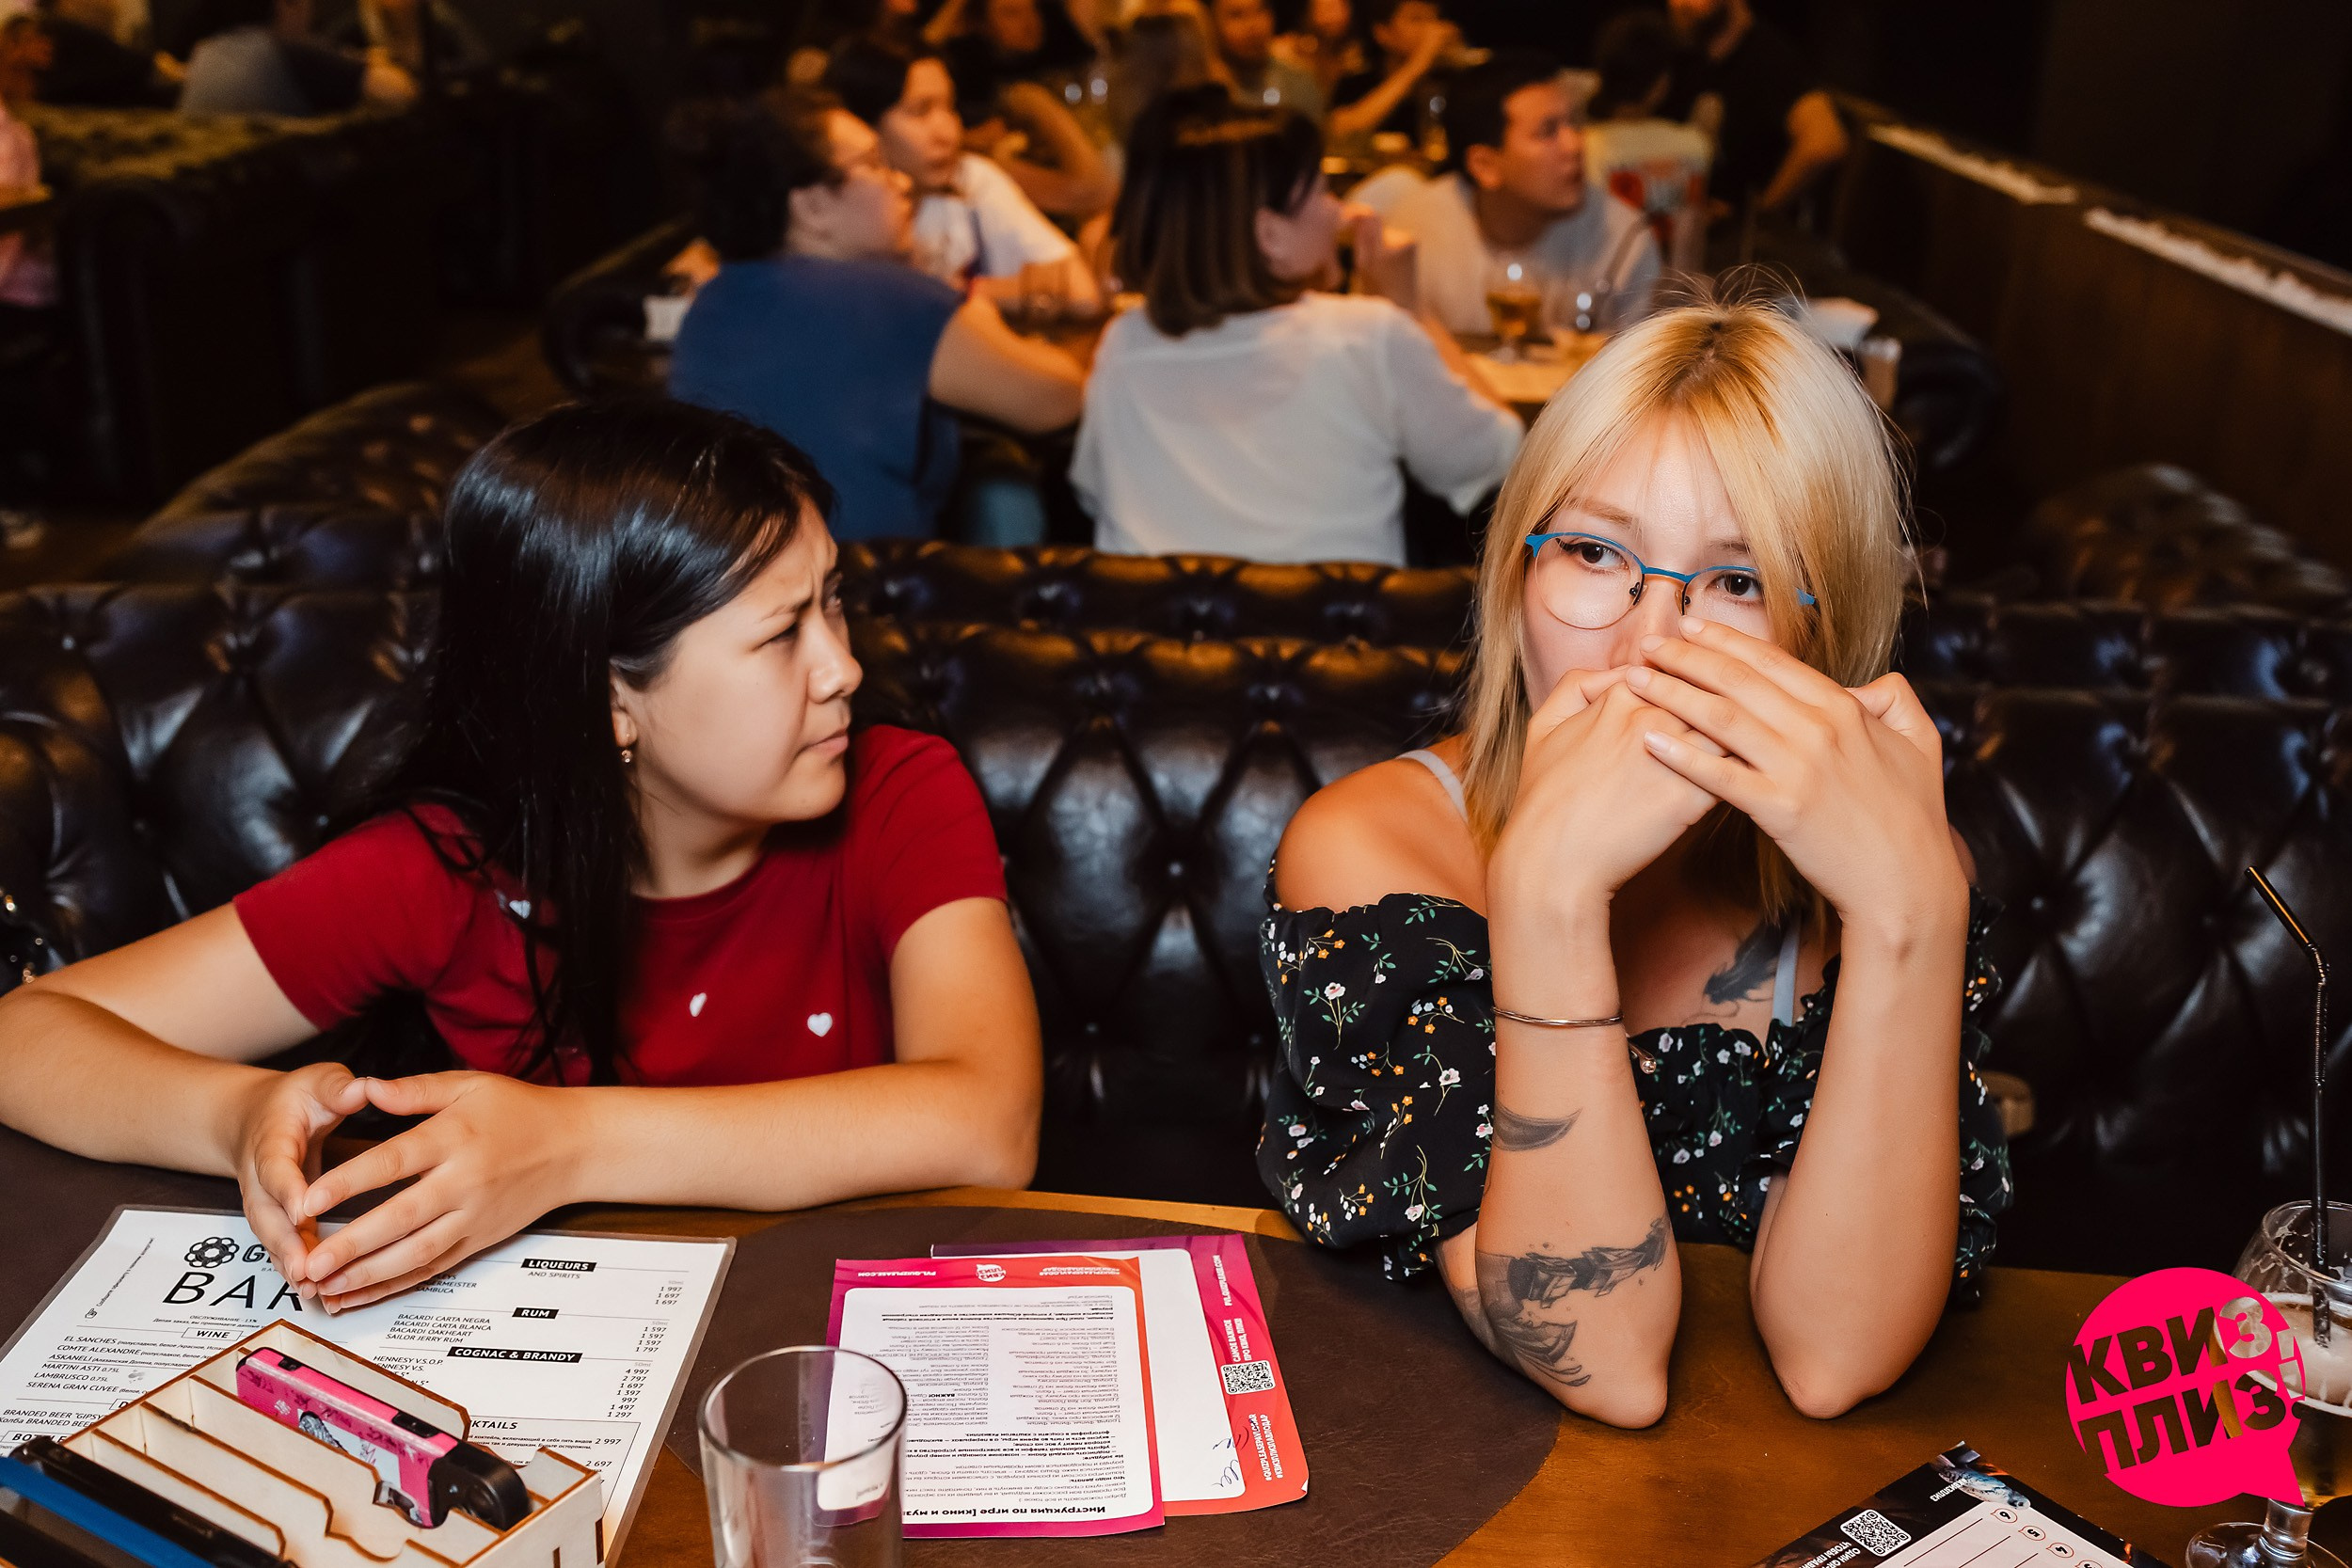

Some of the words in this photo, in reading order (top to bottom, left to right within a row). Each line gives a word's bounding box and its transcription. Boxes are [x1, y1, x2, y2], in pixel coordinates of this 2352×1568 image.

[529, 1260, 589, 1270] LIQUEURS
[521, 1309, 550, 1318] RUM
[88, 1346, 140, 1355] ALEXANDRE
[455, 1348, 507, 1357] COGNAC
[523, 1352, 575, 1361] BRANDY
[34, 1372, 89, 1380] LAMBRUSCO
[471, 1420, 518, 1429] KTAILS
[2000, 1511, 2011, 1519] 6
[1826, 1541, 1852, 1558] ЧТОБЫ
[2055, 1546, 2067, 1554] 4
[1838, 1548, 1861, 1563] ОДИН
